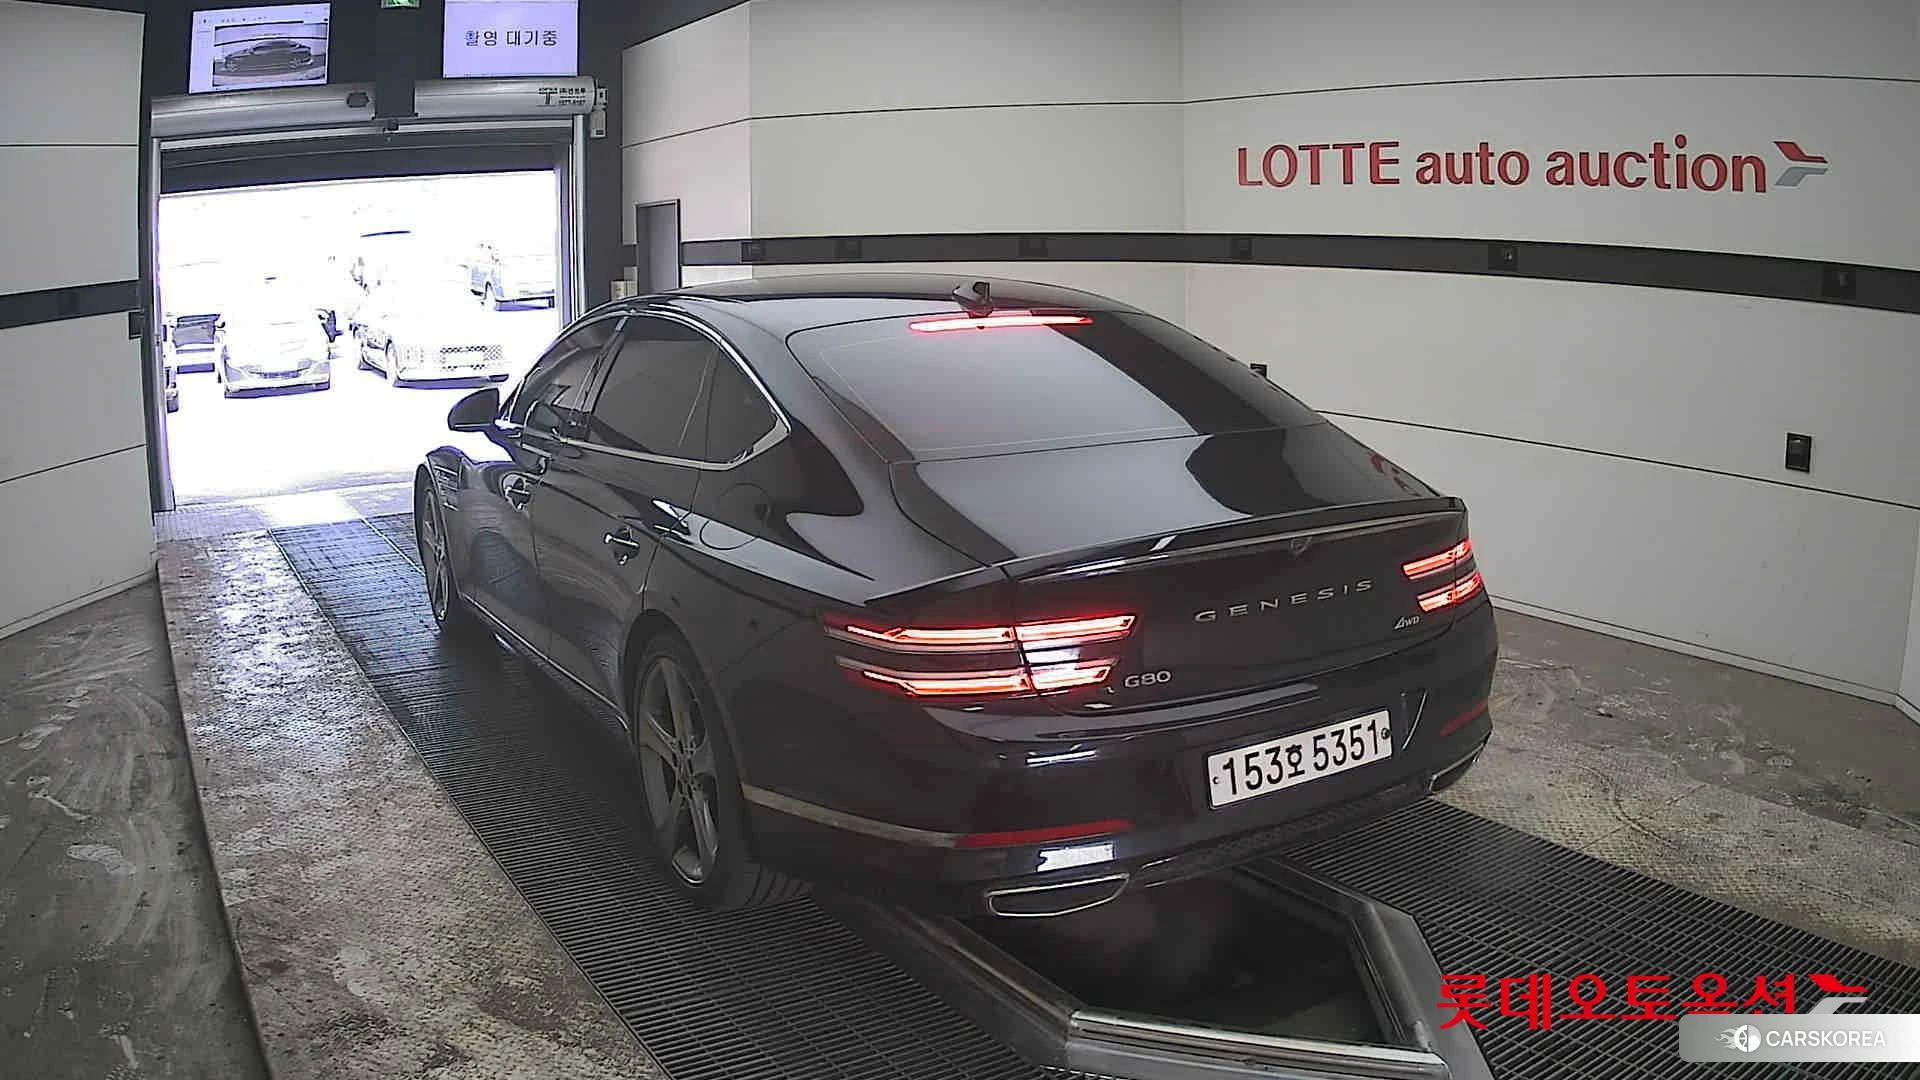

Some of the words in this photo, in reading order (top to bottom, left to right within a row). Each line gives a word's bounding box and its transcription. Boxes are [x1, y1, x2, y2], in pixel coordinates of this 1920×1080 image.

[465, 30, 497, 46] 촬영
[506, 30, 557, 46] 대기중
[1237, 141, 1400, 187] LOTTE
[1415, 141, 1530, 186] auto
[1545, 134, 1767, 193] auction
[1194, 579, 1374, 623] GENESIS
[1123, 669, 1173, 690] G80
